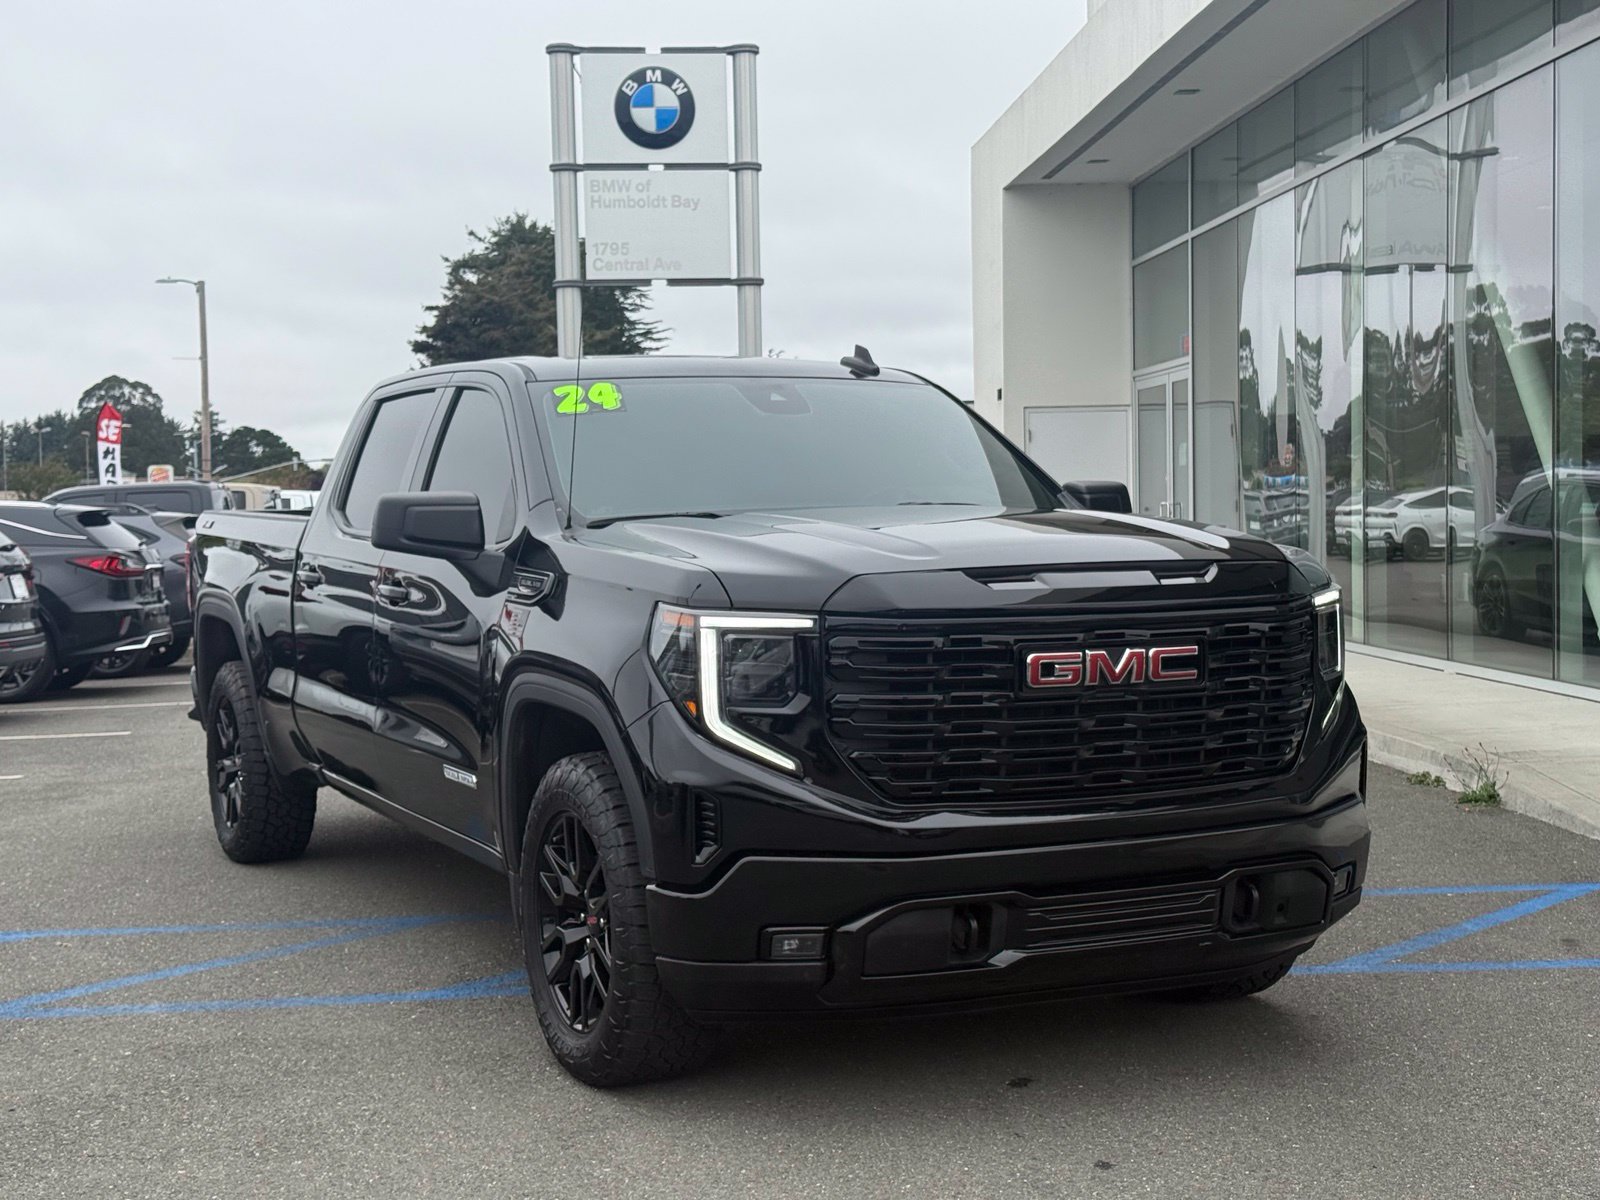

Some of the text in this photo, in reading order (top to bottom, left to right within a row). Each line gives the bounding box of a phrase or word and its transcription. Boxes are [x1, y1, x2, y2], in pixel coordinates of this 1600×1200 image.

[621, 69, 688, 96] BMW
[590, 179, 652, 193] BMW of
[590, 195, 700, 211] Humboldt Bay
[592, 242, 630, 256] 1795
[592, 258, 682, 272] Central Ave
[553, 382, 622, 414] 24
[98, 418, 122, 441] SE
[1026, 646, 1198, 688] GMC
